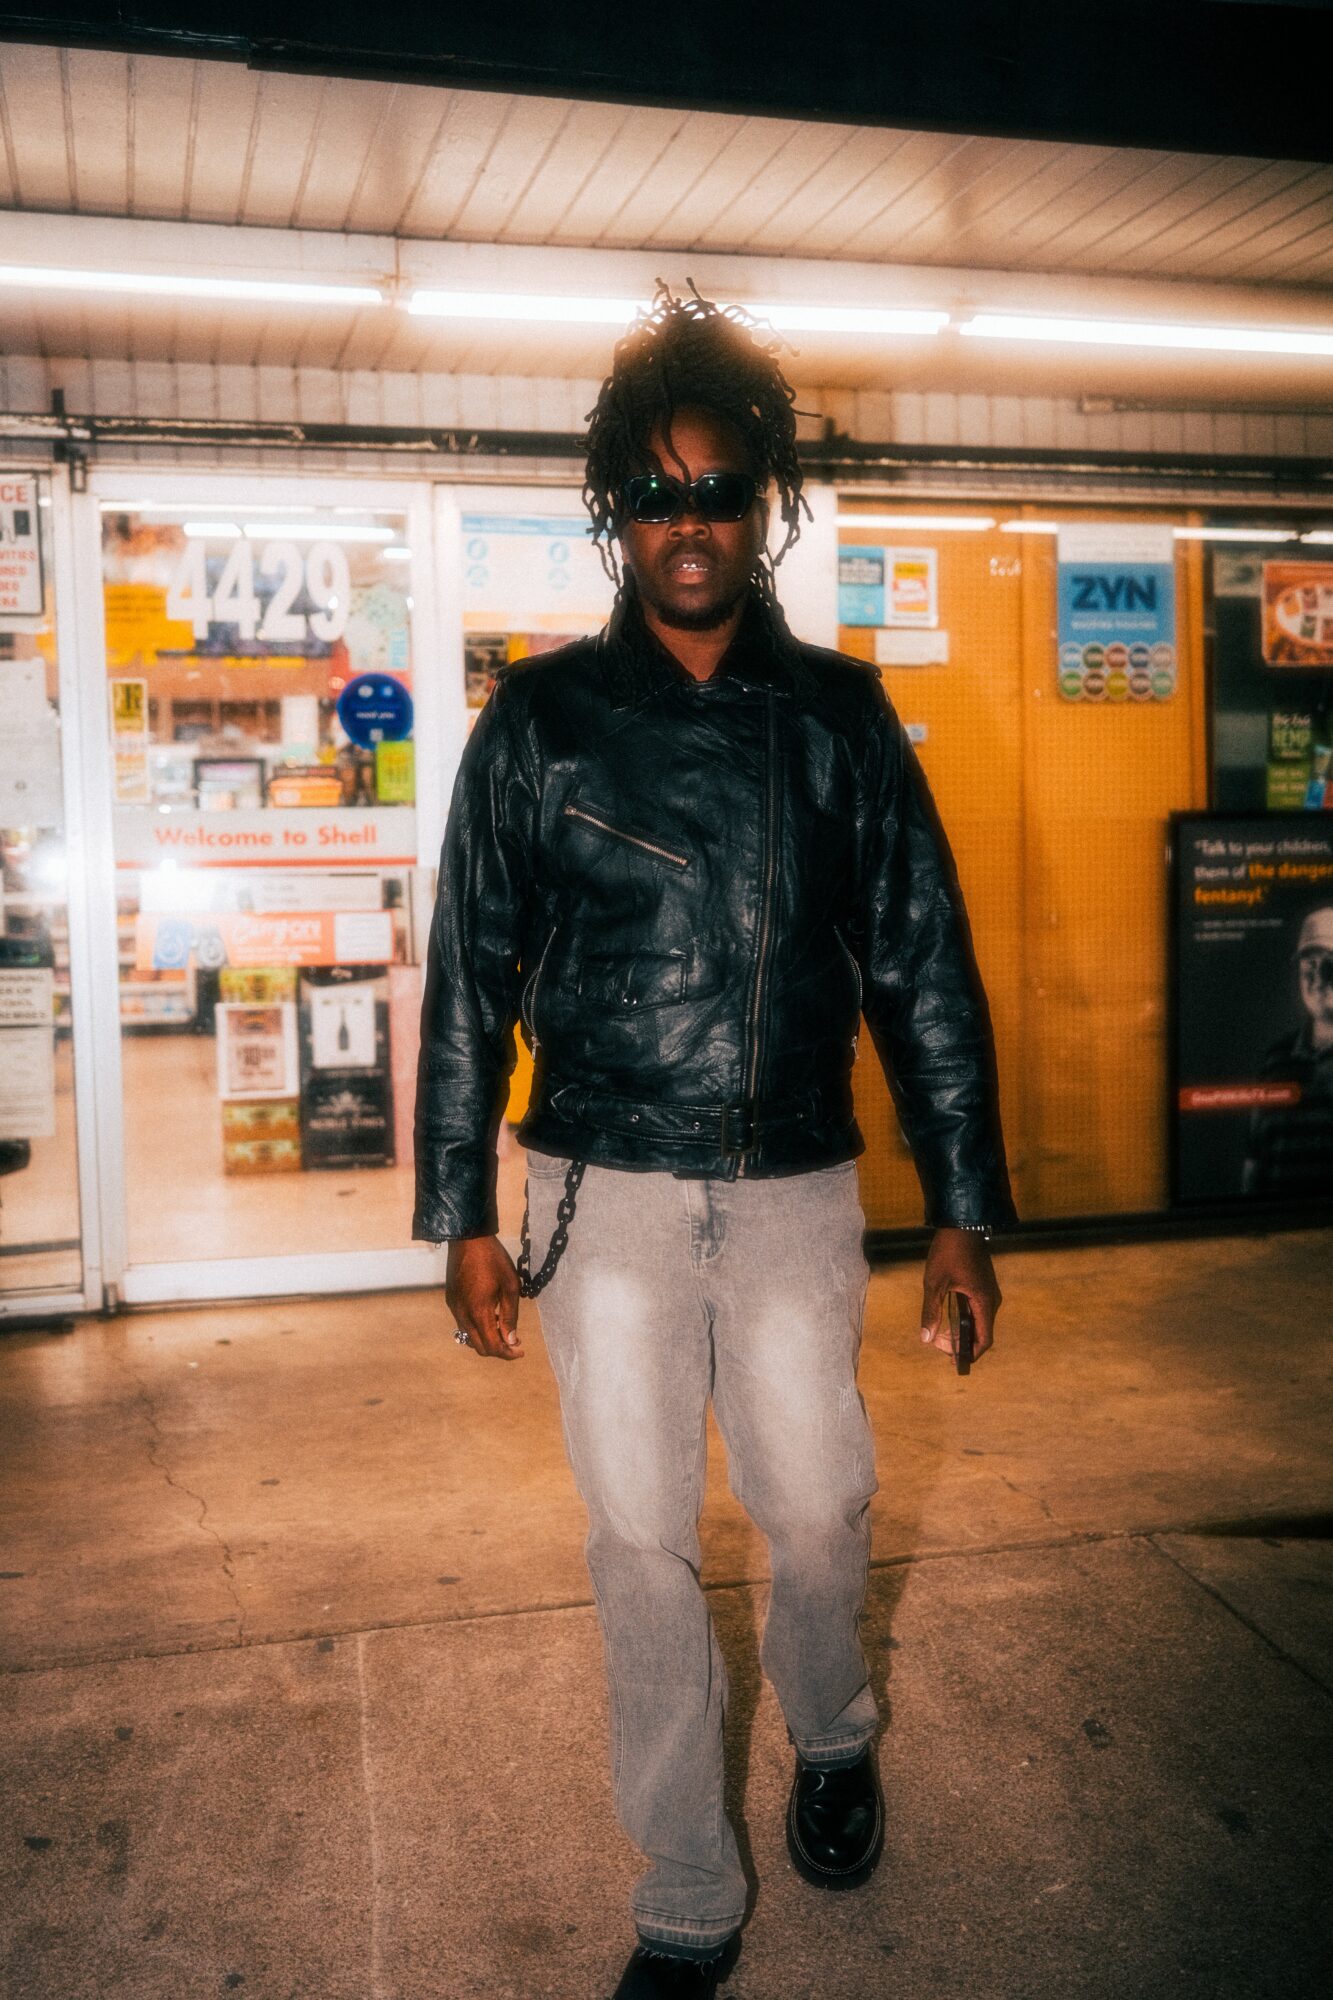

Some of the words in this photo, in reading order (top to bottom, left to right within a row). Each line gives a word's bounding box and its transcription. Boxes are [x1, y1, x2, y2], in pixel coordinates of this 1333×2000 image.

[167, 539, 350, 642] 4429
[1071, 575, 1158, 612] ZYN
[154, 825, 274, 847] Welcome
[283, 828, 308, 846] to
[317, 824, 378, 846] Shell
